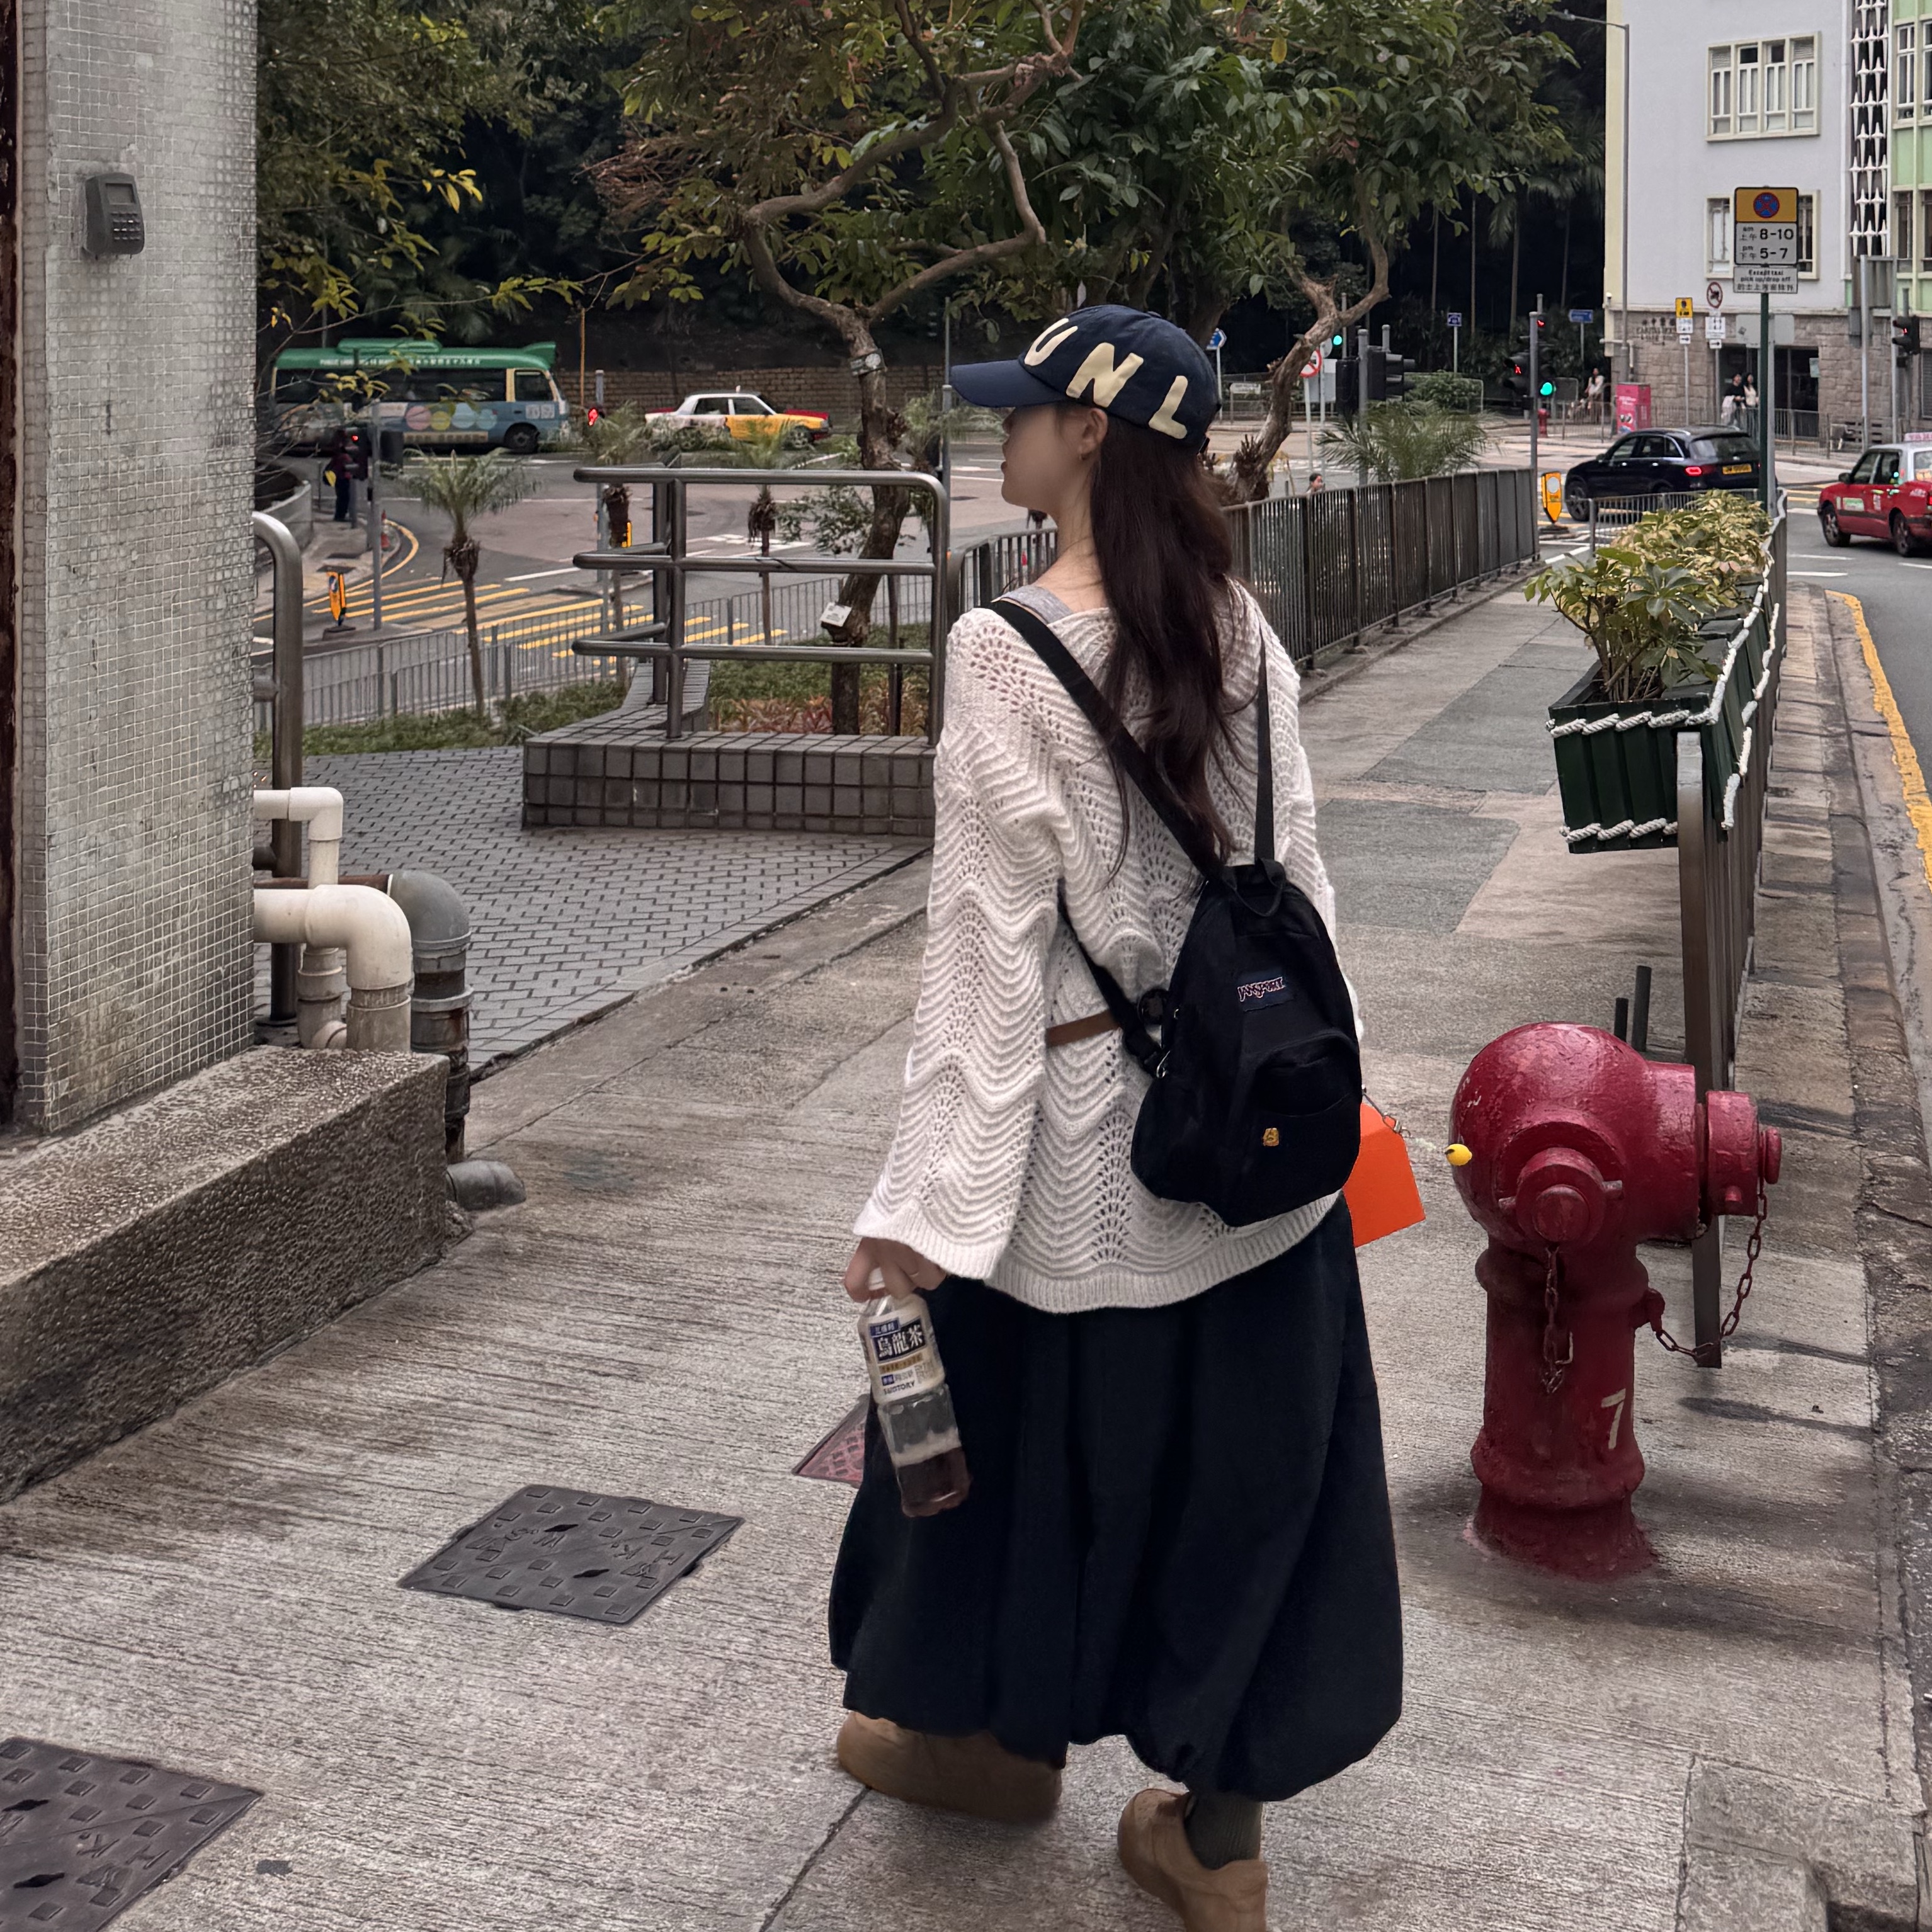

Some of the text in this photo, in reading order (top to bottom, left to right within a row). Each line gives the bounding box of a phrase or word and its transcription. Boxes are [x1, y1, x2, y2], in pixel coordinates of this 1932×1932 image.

[1739, 233, 1757, 241] 上午
[1759, 228, 1794, 240] 8-10
[1760, 247, 1788, 259] 5-7
[878, 1324, 923, 1357] 烏龍茶
[1601, 1387, 1627, 1450] 7
